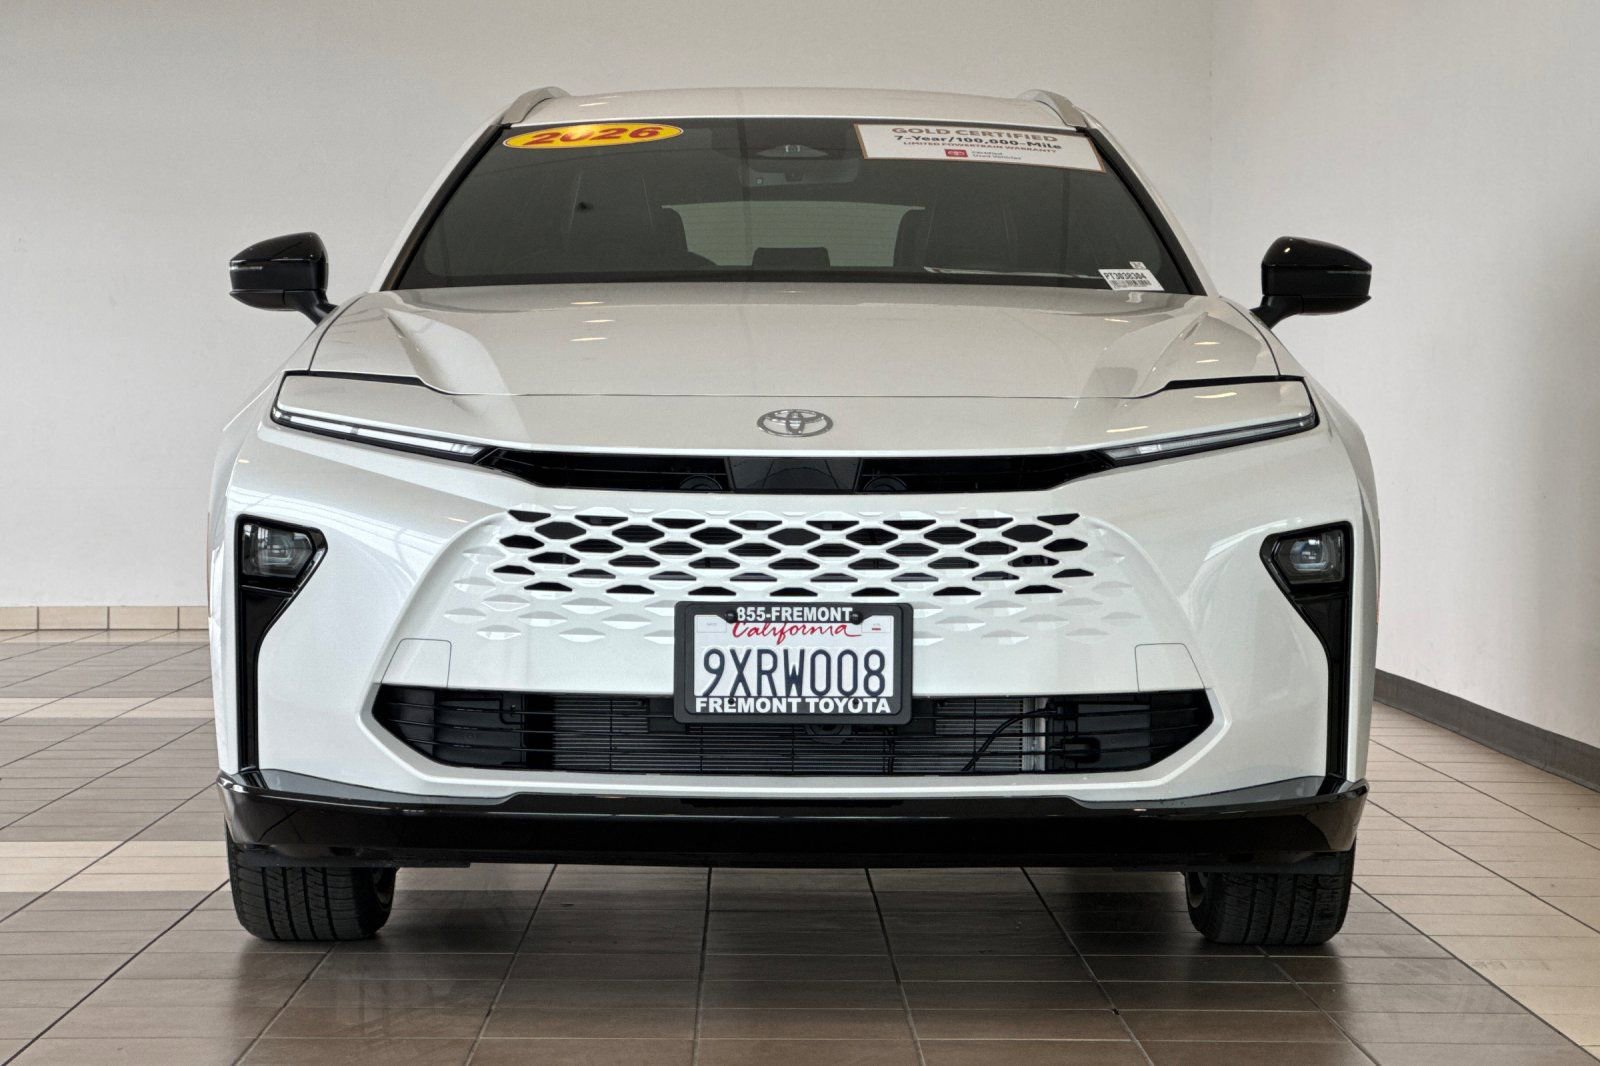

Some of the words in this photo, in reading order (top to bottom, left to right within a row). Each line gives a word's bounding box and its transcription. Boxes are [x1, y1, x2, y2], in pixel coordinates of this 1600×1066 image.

[522, 127, 662, 146] 2026
[892, 127, 951, 135] GOLD
[955, 129, 1058, 142] CERTIFIED
[736, 606, 853, 622] 855-FREMONT
[731, 621, 862, 645] California
[702, 648, 886, 698] 9XRW008
[695, 697, 802, 714] FREMONT
[805, 697, 892, 714] TOYOTA
